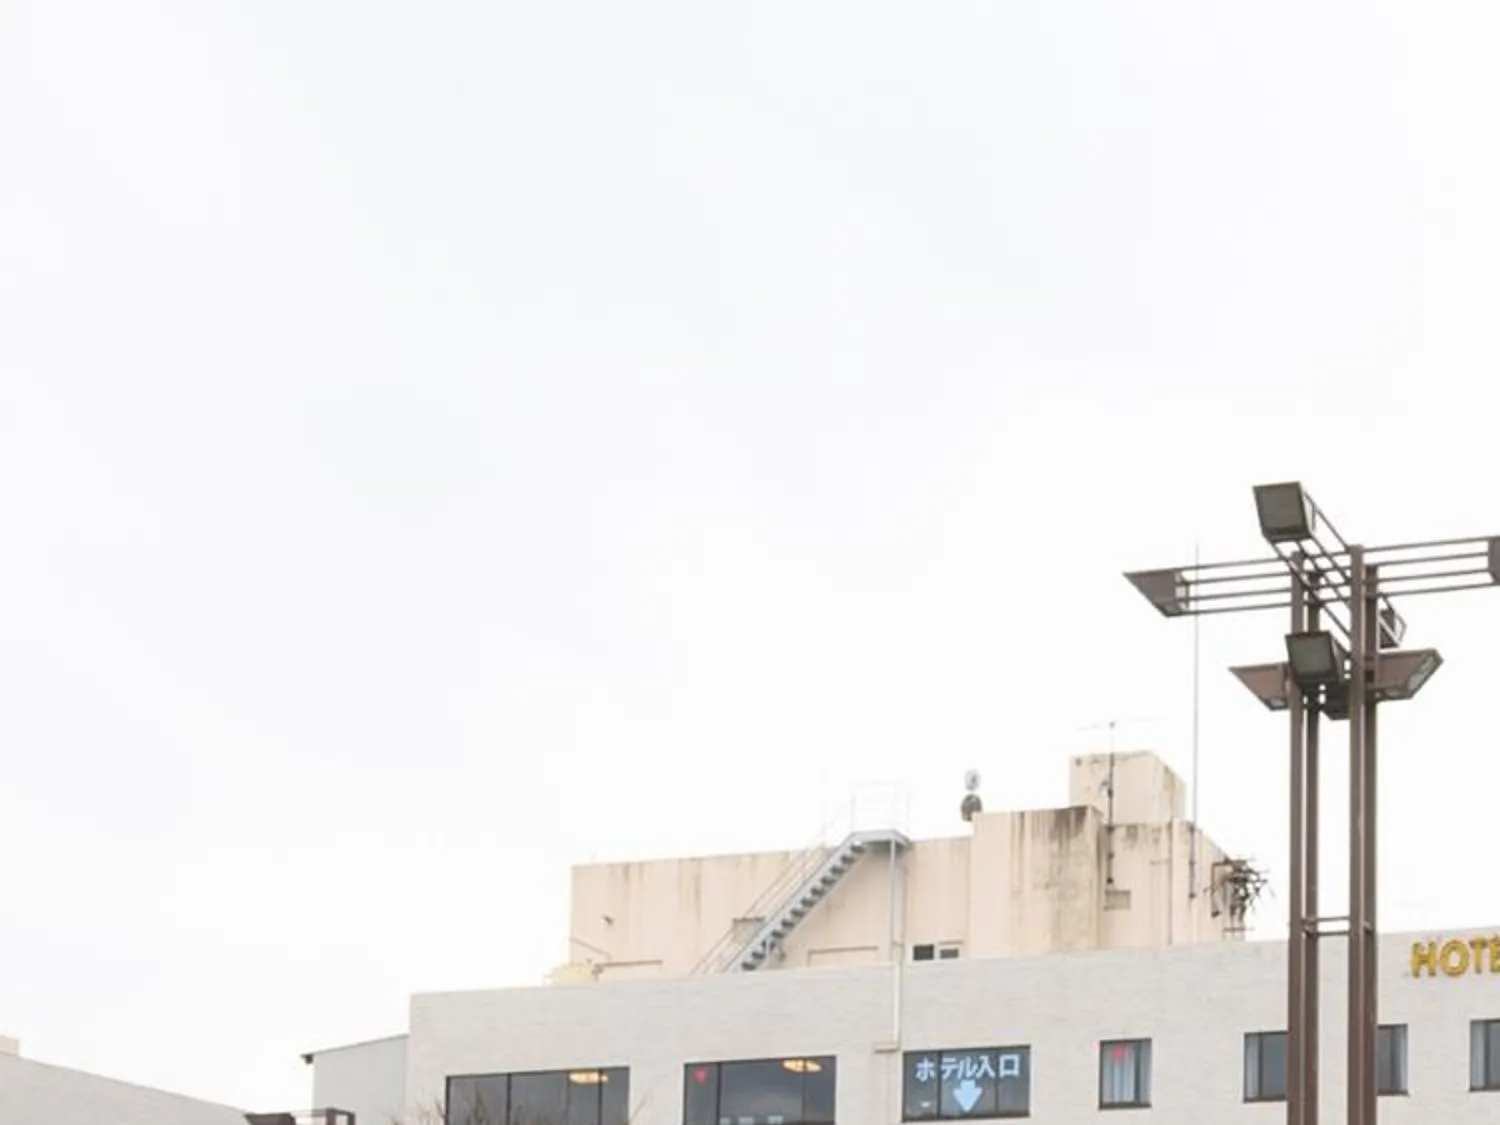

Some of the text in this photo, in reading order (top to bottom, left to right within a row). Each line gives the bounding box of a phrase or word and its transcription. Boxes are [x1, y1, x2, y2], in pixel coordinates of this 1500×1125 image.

[915, 1052, 1021, 1082] ホテル入口
